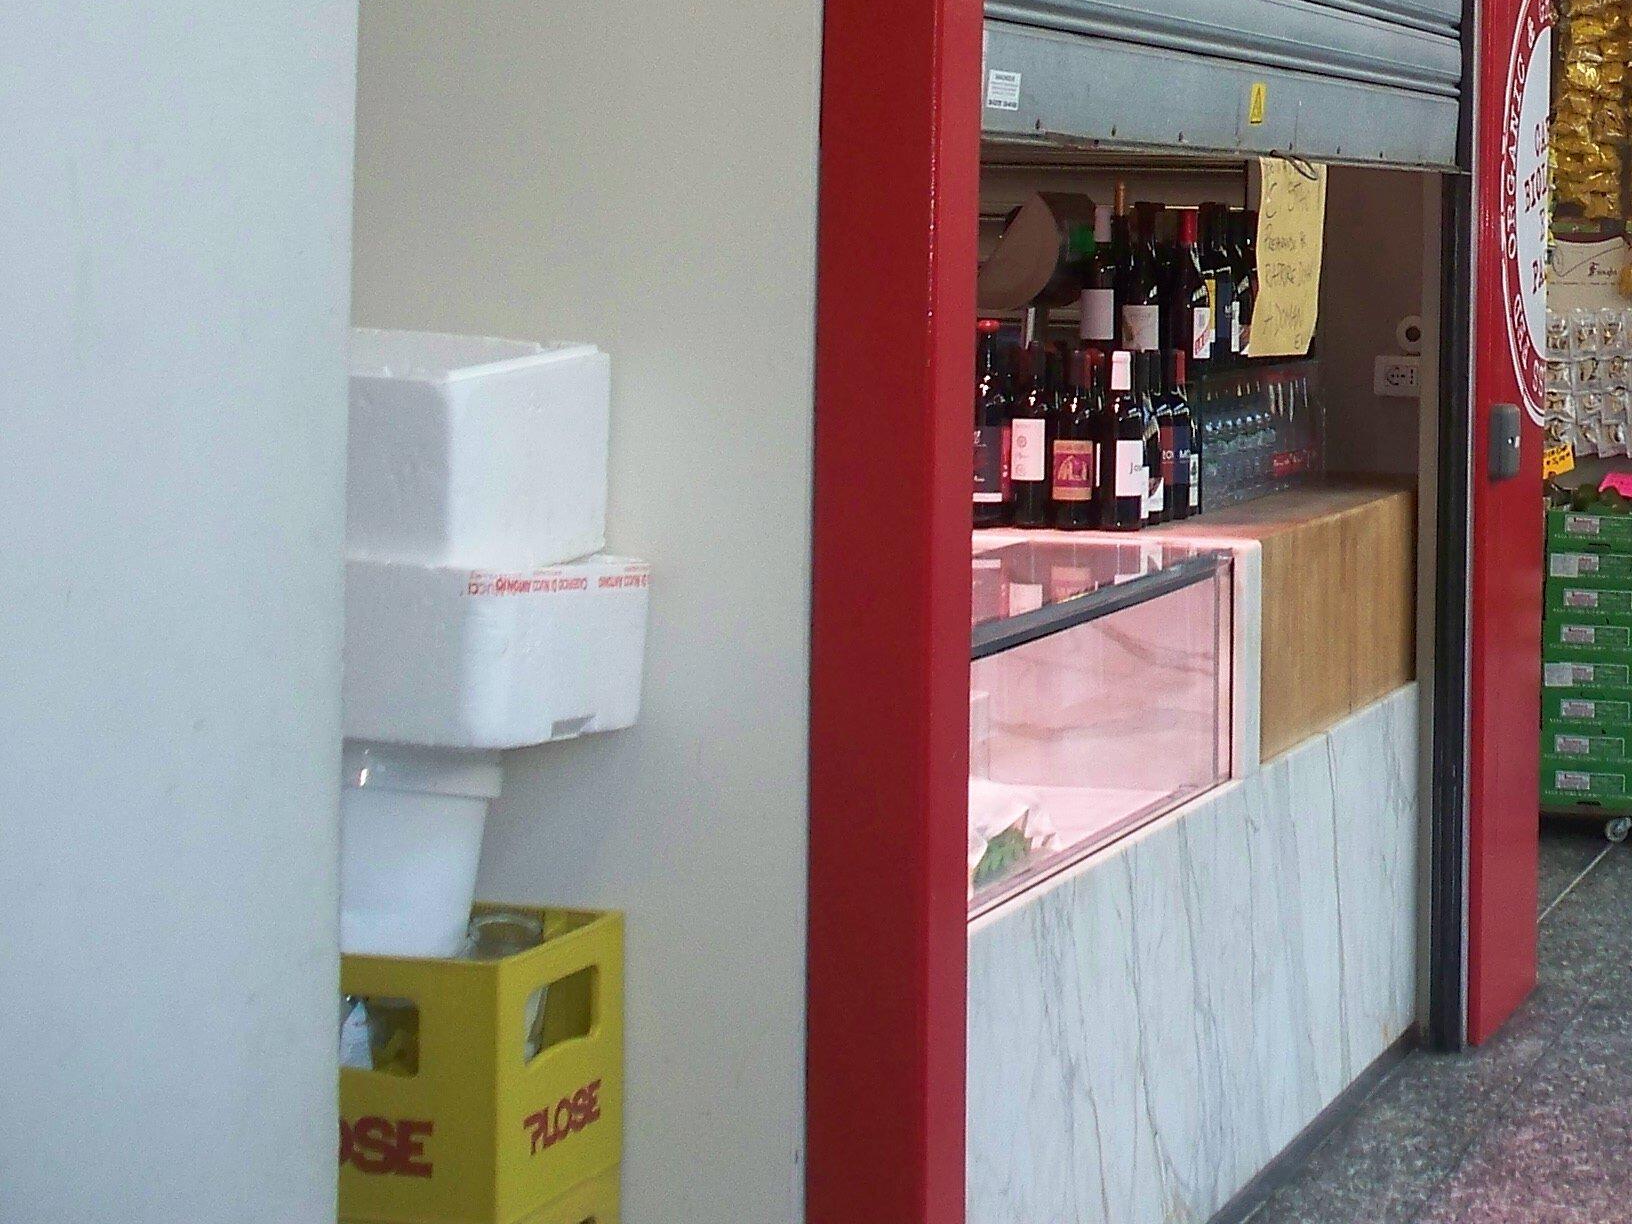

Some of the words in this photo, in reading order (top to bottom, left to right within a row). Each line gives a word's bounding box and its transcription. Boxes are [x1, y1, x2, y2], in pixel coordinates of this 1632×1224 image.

[1506, 53, 1526, 260] ORGANIC
[1523, 163, 1548, 213] BIOL
[523, 1078, 602, 1156] PLOSE
